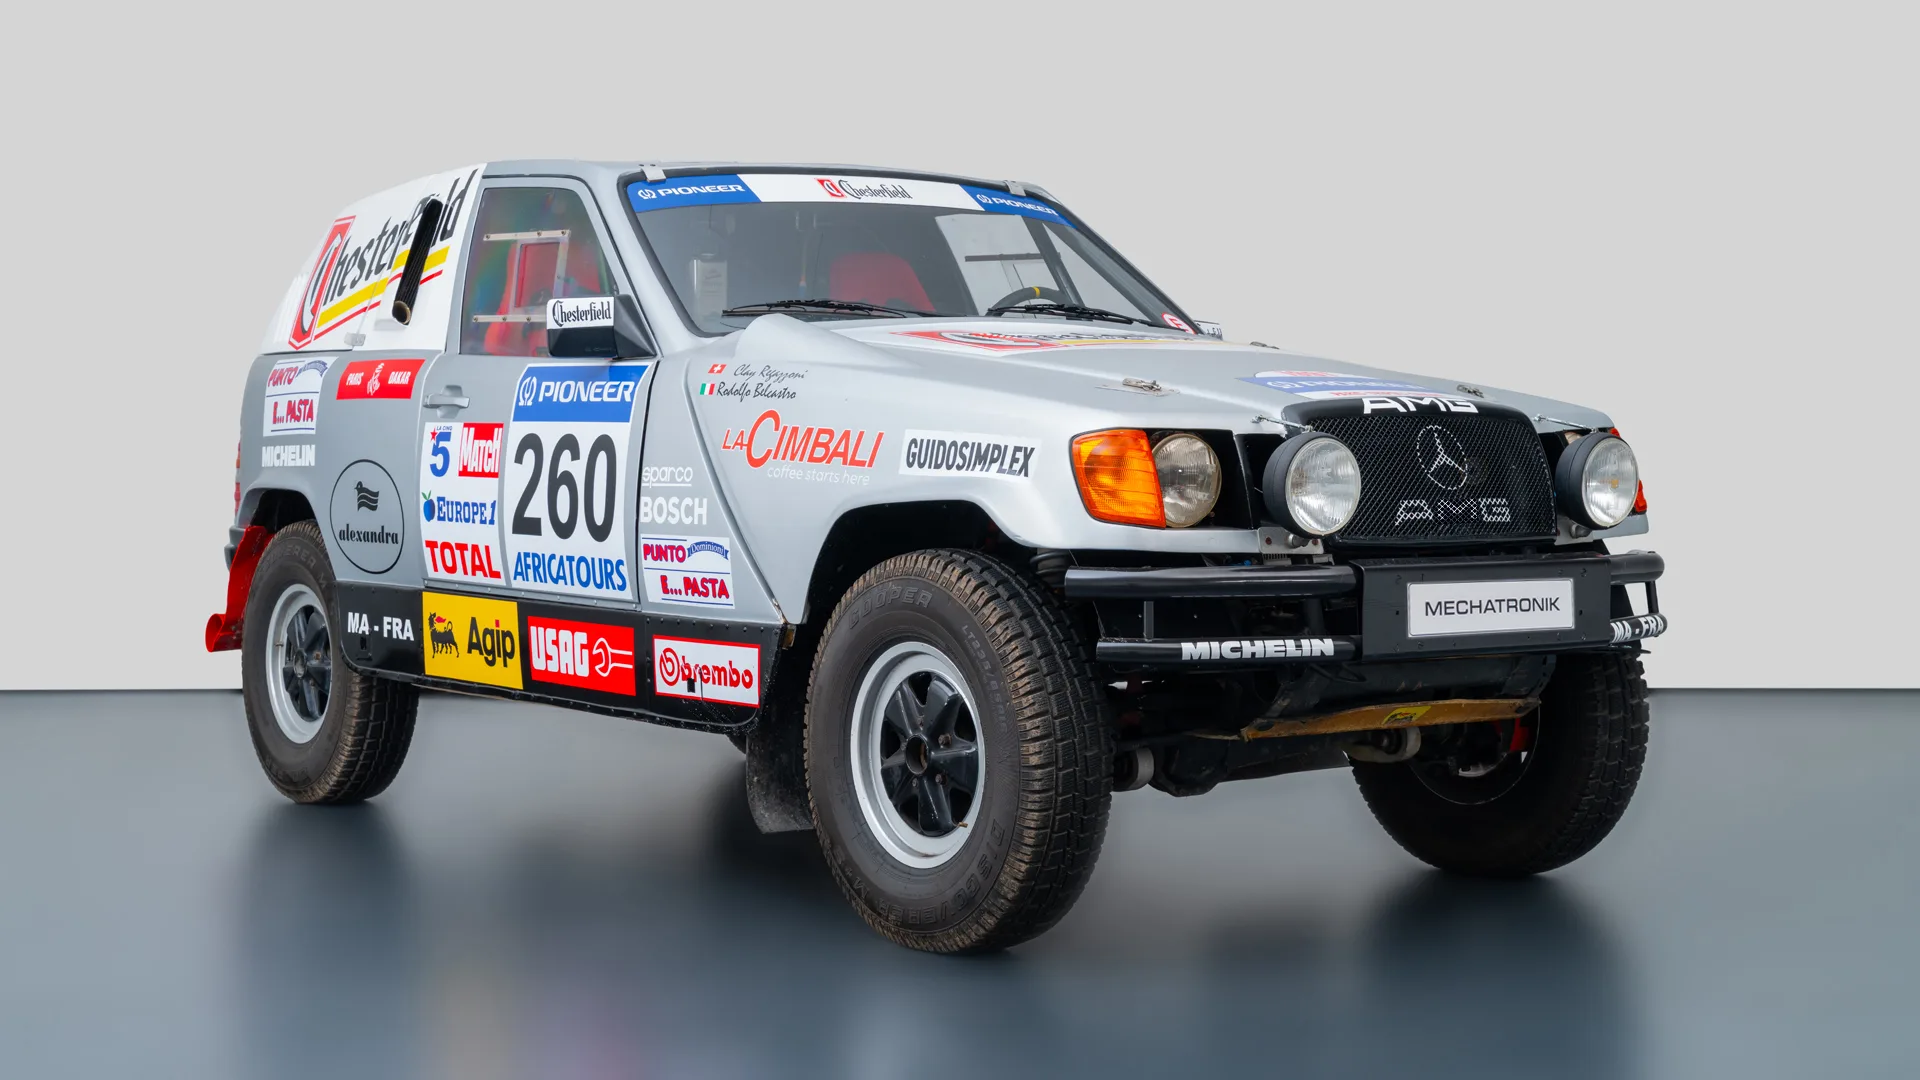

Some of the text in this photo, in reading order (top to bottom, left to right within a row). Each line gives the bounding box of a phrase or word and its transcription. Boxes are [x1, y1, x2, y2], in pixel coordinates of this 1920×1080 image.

[657, 184, 745, 197] PIONEER
[838, 179, 913, 200] Chesterfield
[991, 197, 1059, 217] PIONEER
[301, 168, 478, 334] Chesterfld
[552, 300, 612, 327] Chesterfield
[268, 366, 299, 388] PUNTO
[346, 371, 411, 386] PARIS DAKAR
[538, 380, 636, 403] PIONEER
[717, 381, 796, 403] Rodolfo Belcastro
[285, 399, 314, 424] PASTA
[1362, 396, 1478, 414] AMG
[722, 410, 885, 469] LA CIMBALI
[262, 445, 316, 467] MICHELIN
[430, 432, 451, 477] 5
[906, 438, 1035, 477] GUIDOSIMPLEX
[512, 433, 617, 542] 260
[642, 466, 693, 488] sparco
[767, 466, 870, 486] coffee starts here
[641, 496, 707, 525] BOSCH
[1395, 498, 1511, 526] AMG
[339, 524, 398, 544] alexandra
[425, 540, 501, 579] TOTAL
[643, 543, 687, 563] PUNTO
[513, 551, 627, 592] AFRICATOURS
[683, 577, 729, 599] PASTA
[850, 586, 933, 629] COOPER
[1424, 597, 1560, 617] MECHATRONIK
[347, 612, 370, 635] MA
[383, 616, 415, 642] FRA
[1638, 615, 1664, 638] FRA
[467, 617, 516, 668] Agip
[530, 626, 589, 677] USAG
[1181, 638, 1335, 661] MICHELIN
[681, 656, 753, 689] brembo
